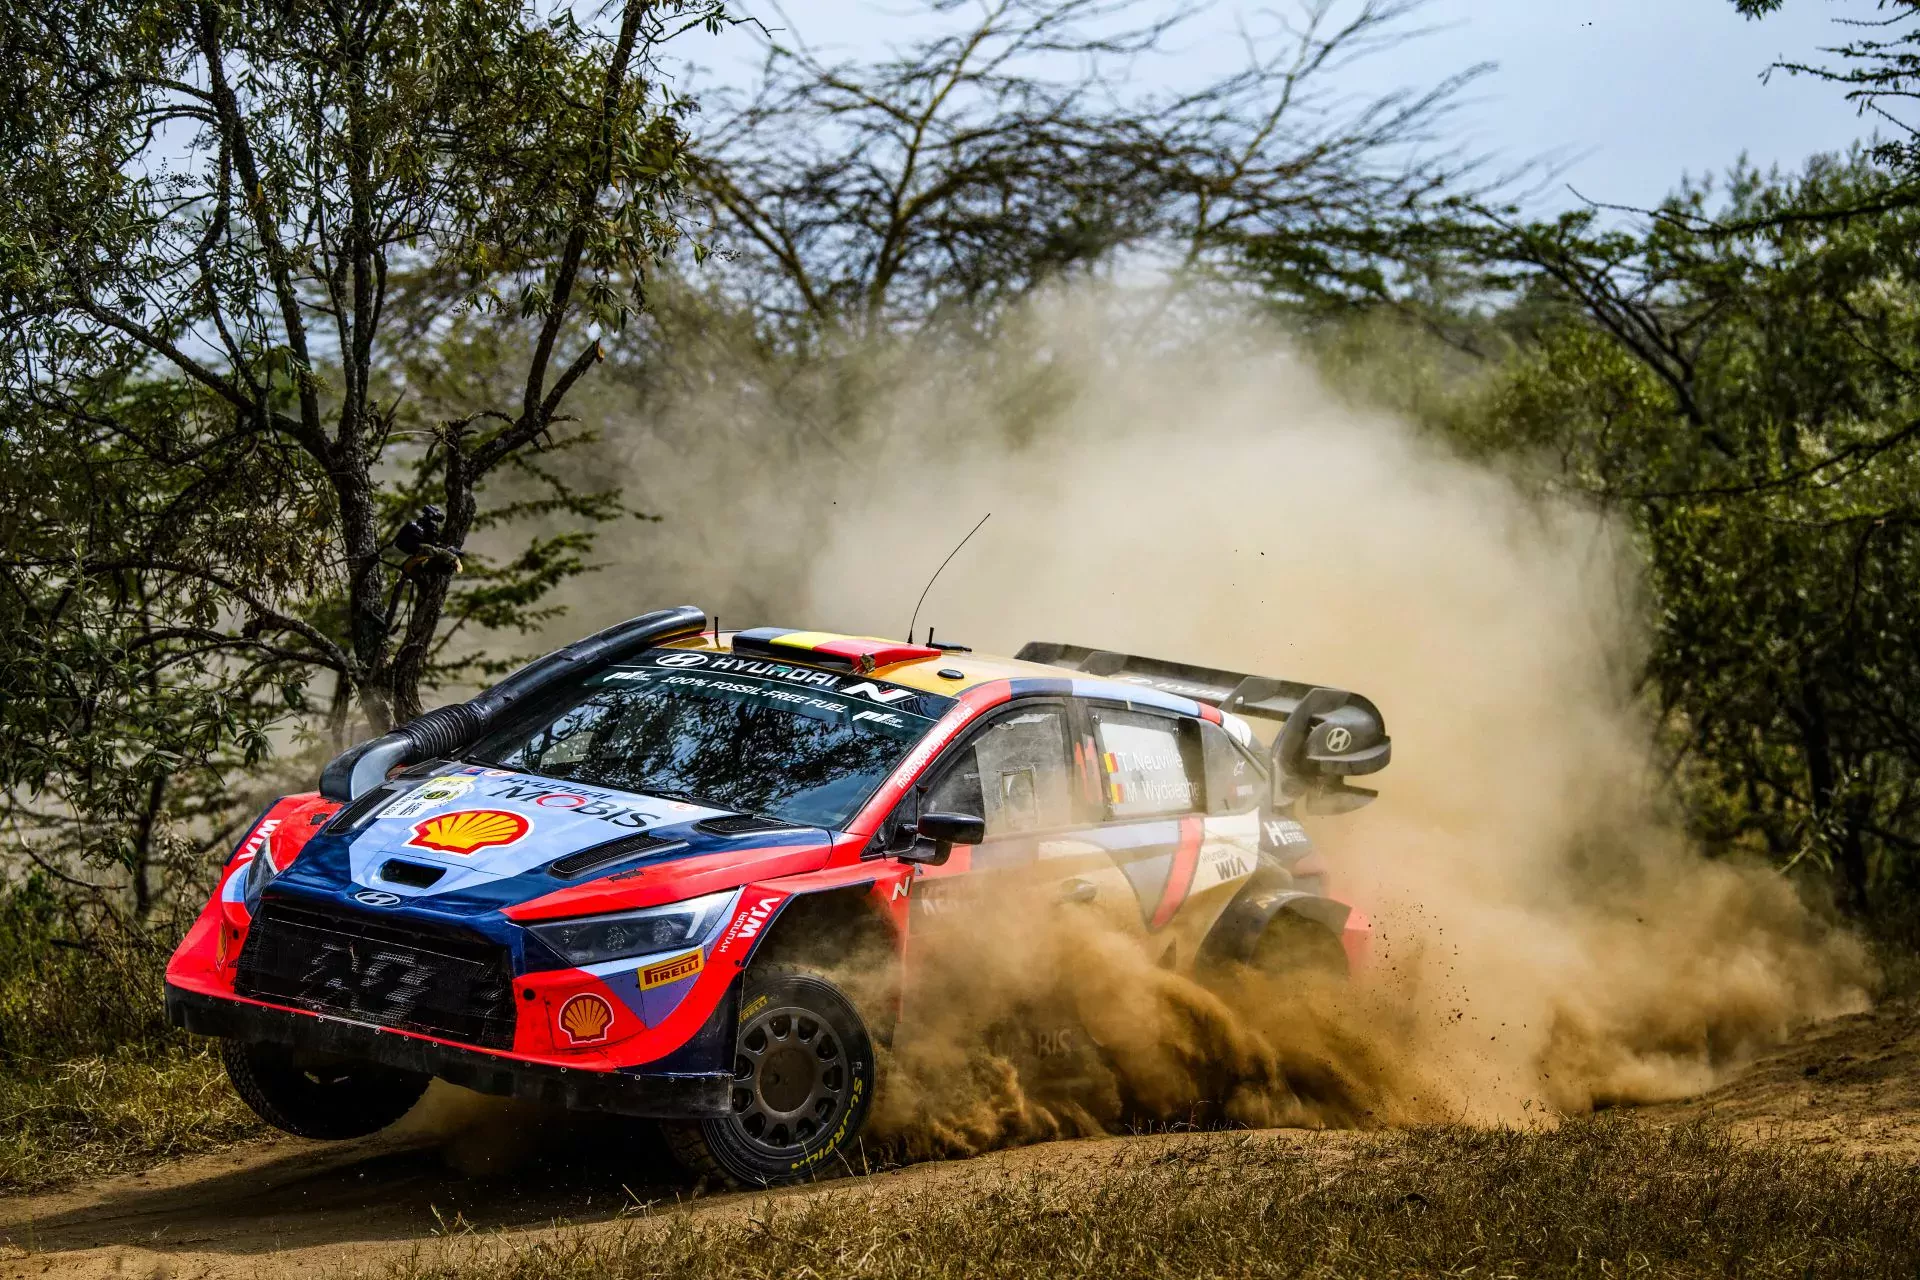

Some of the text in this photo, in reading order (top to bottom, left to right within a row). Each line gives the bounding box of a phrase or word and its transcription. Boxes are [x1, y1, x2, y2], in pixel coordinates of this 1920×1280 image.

[710, 657, 842, 687] HYUNDAI
[660, 676, 709, 687] 100%
[708, 681, 810, 704] FOSSIL-FREE
[804, 698, 848, 713] FUEL
[1132, 747, 1184, 772] Neuville
[499, 777, 614, 800] HYUNDAI
[486, 785, 662, 828] MOBIS
[1215, 854, 1249, 881] WIA
[719, 911, 749, 953] HYUNDAI
[736, 897, 781, 938] WIA
[644, 954, 699, 985] PIRELLI
